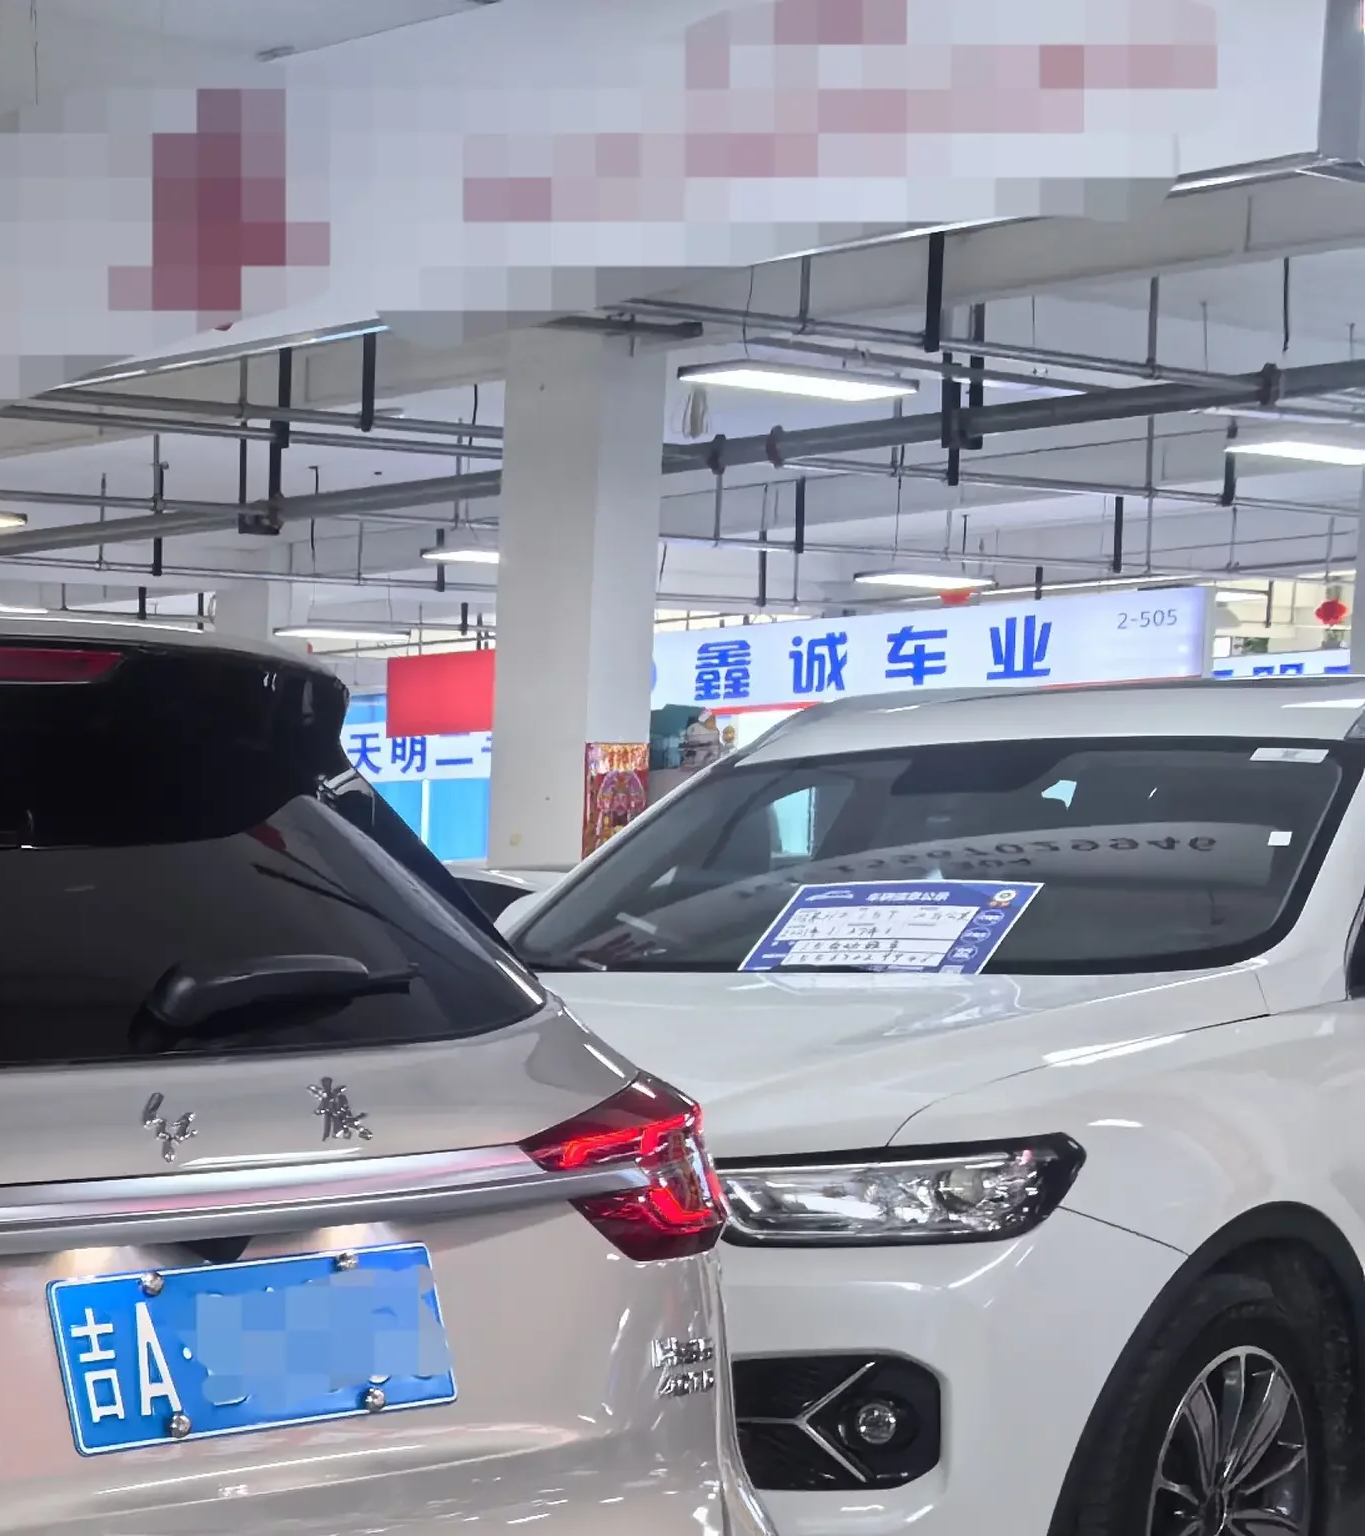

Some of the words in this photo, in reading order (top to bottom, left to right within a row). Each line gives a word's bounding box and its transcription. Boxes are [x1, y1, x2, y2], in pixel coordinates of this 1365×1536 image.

[694, 614, 1053, 701] 鑫诚车业
[1117, 608, 1178, 630] 2-505
